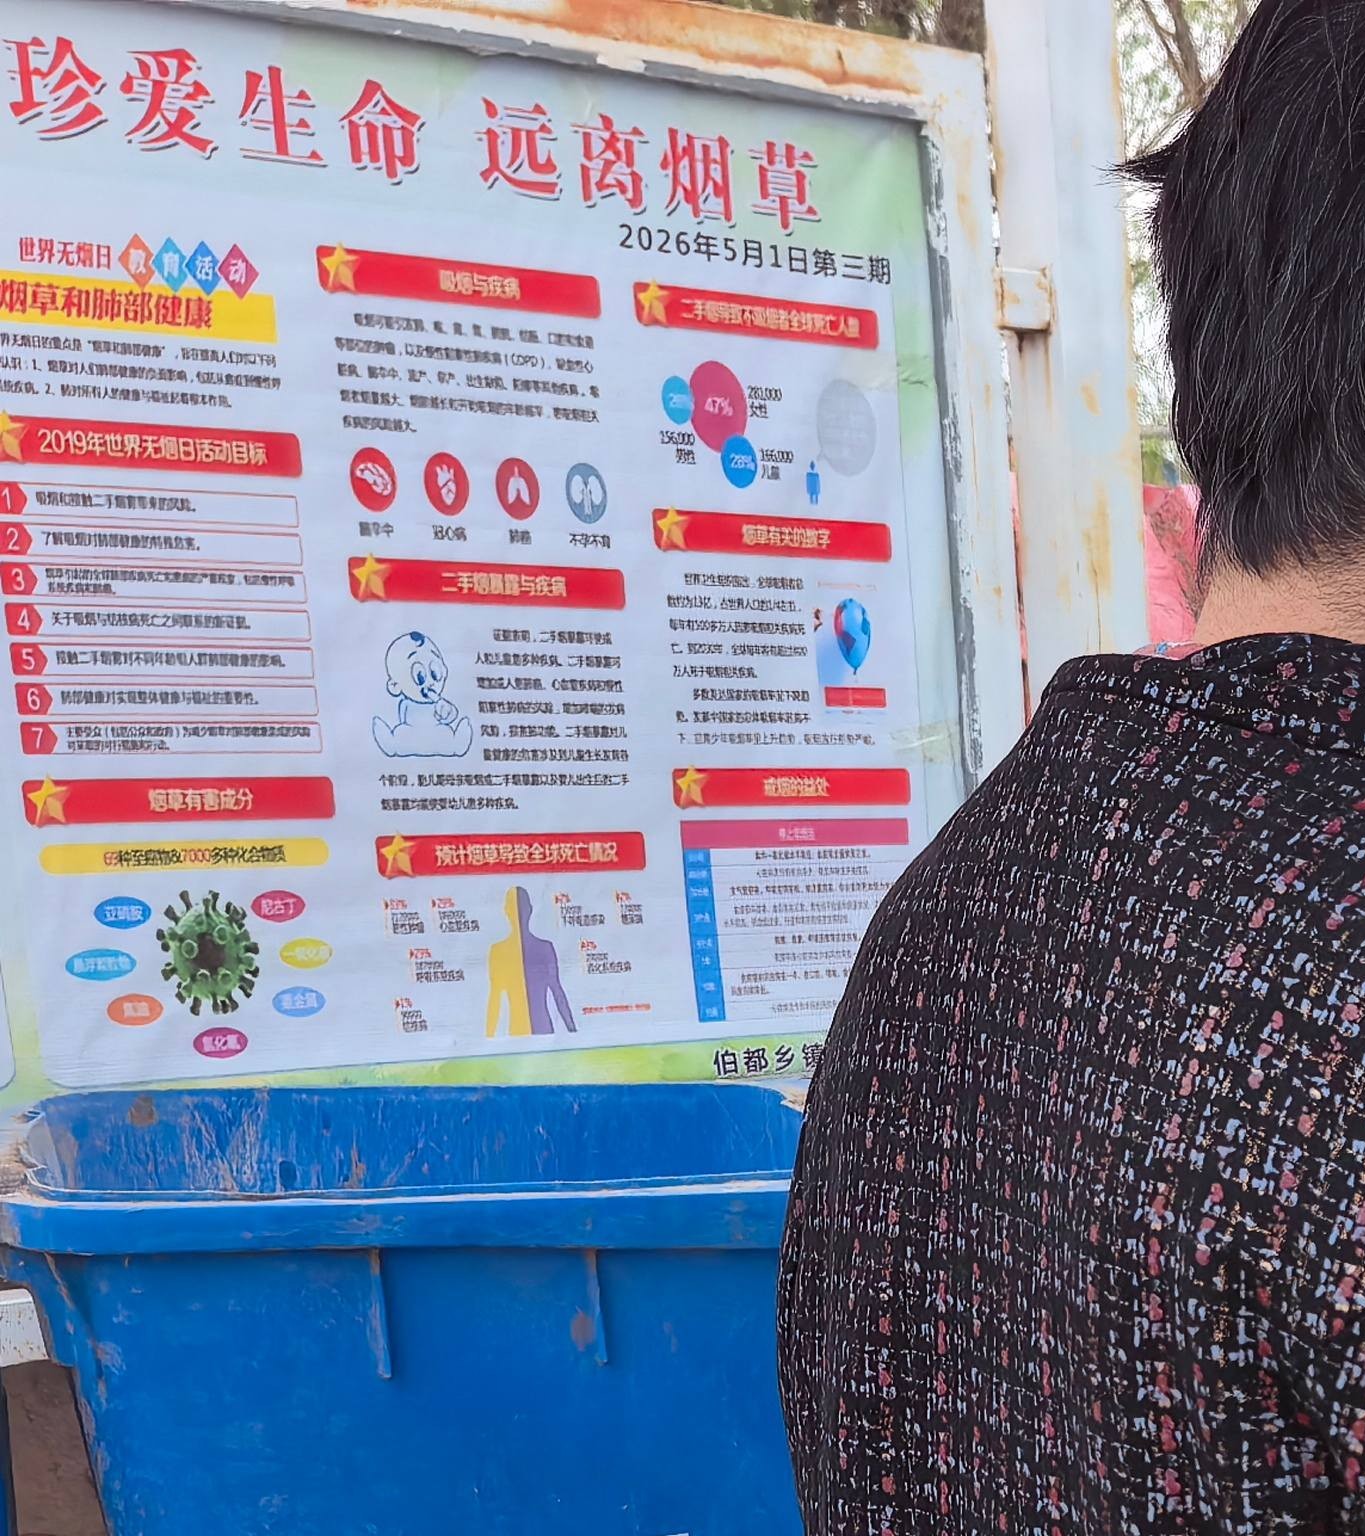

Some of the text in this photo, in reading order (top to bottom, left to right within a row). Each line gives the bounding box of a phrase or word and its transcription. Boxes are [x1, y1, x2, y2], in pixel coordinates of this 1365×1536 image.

[4, 37, 821, 233] 珍爱生命 远离烟草
[19, 237, 111, 269] 世界无烟日
[619, 224, 891, 284] 2026年5月1日第三期
[704, 397, 733, 417] 47%
[37, 428, 268, 466] 2019年世界无烟日活动目标
[149, 788, 253, 812] 烟草有害成分
